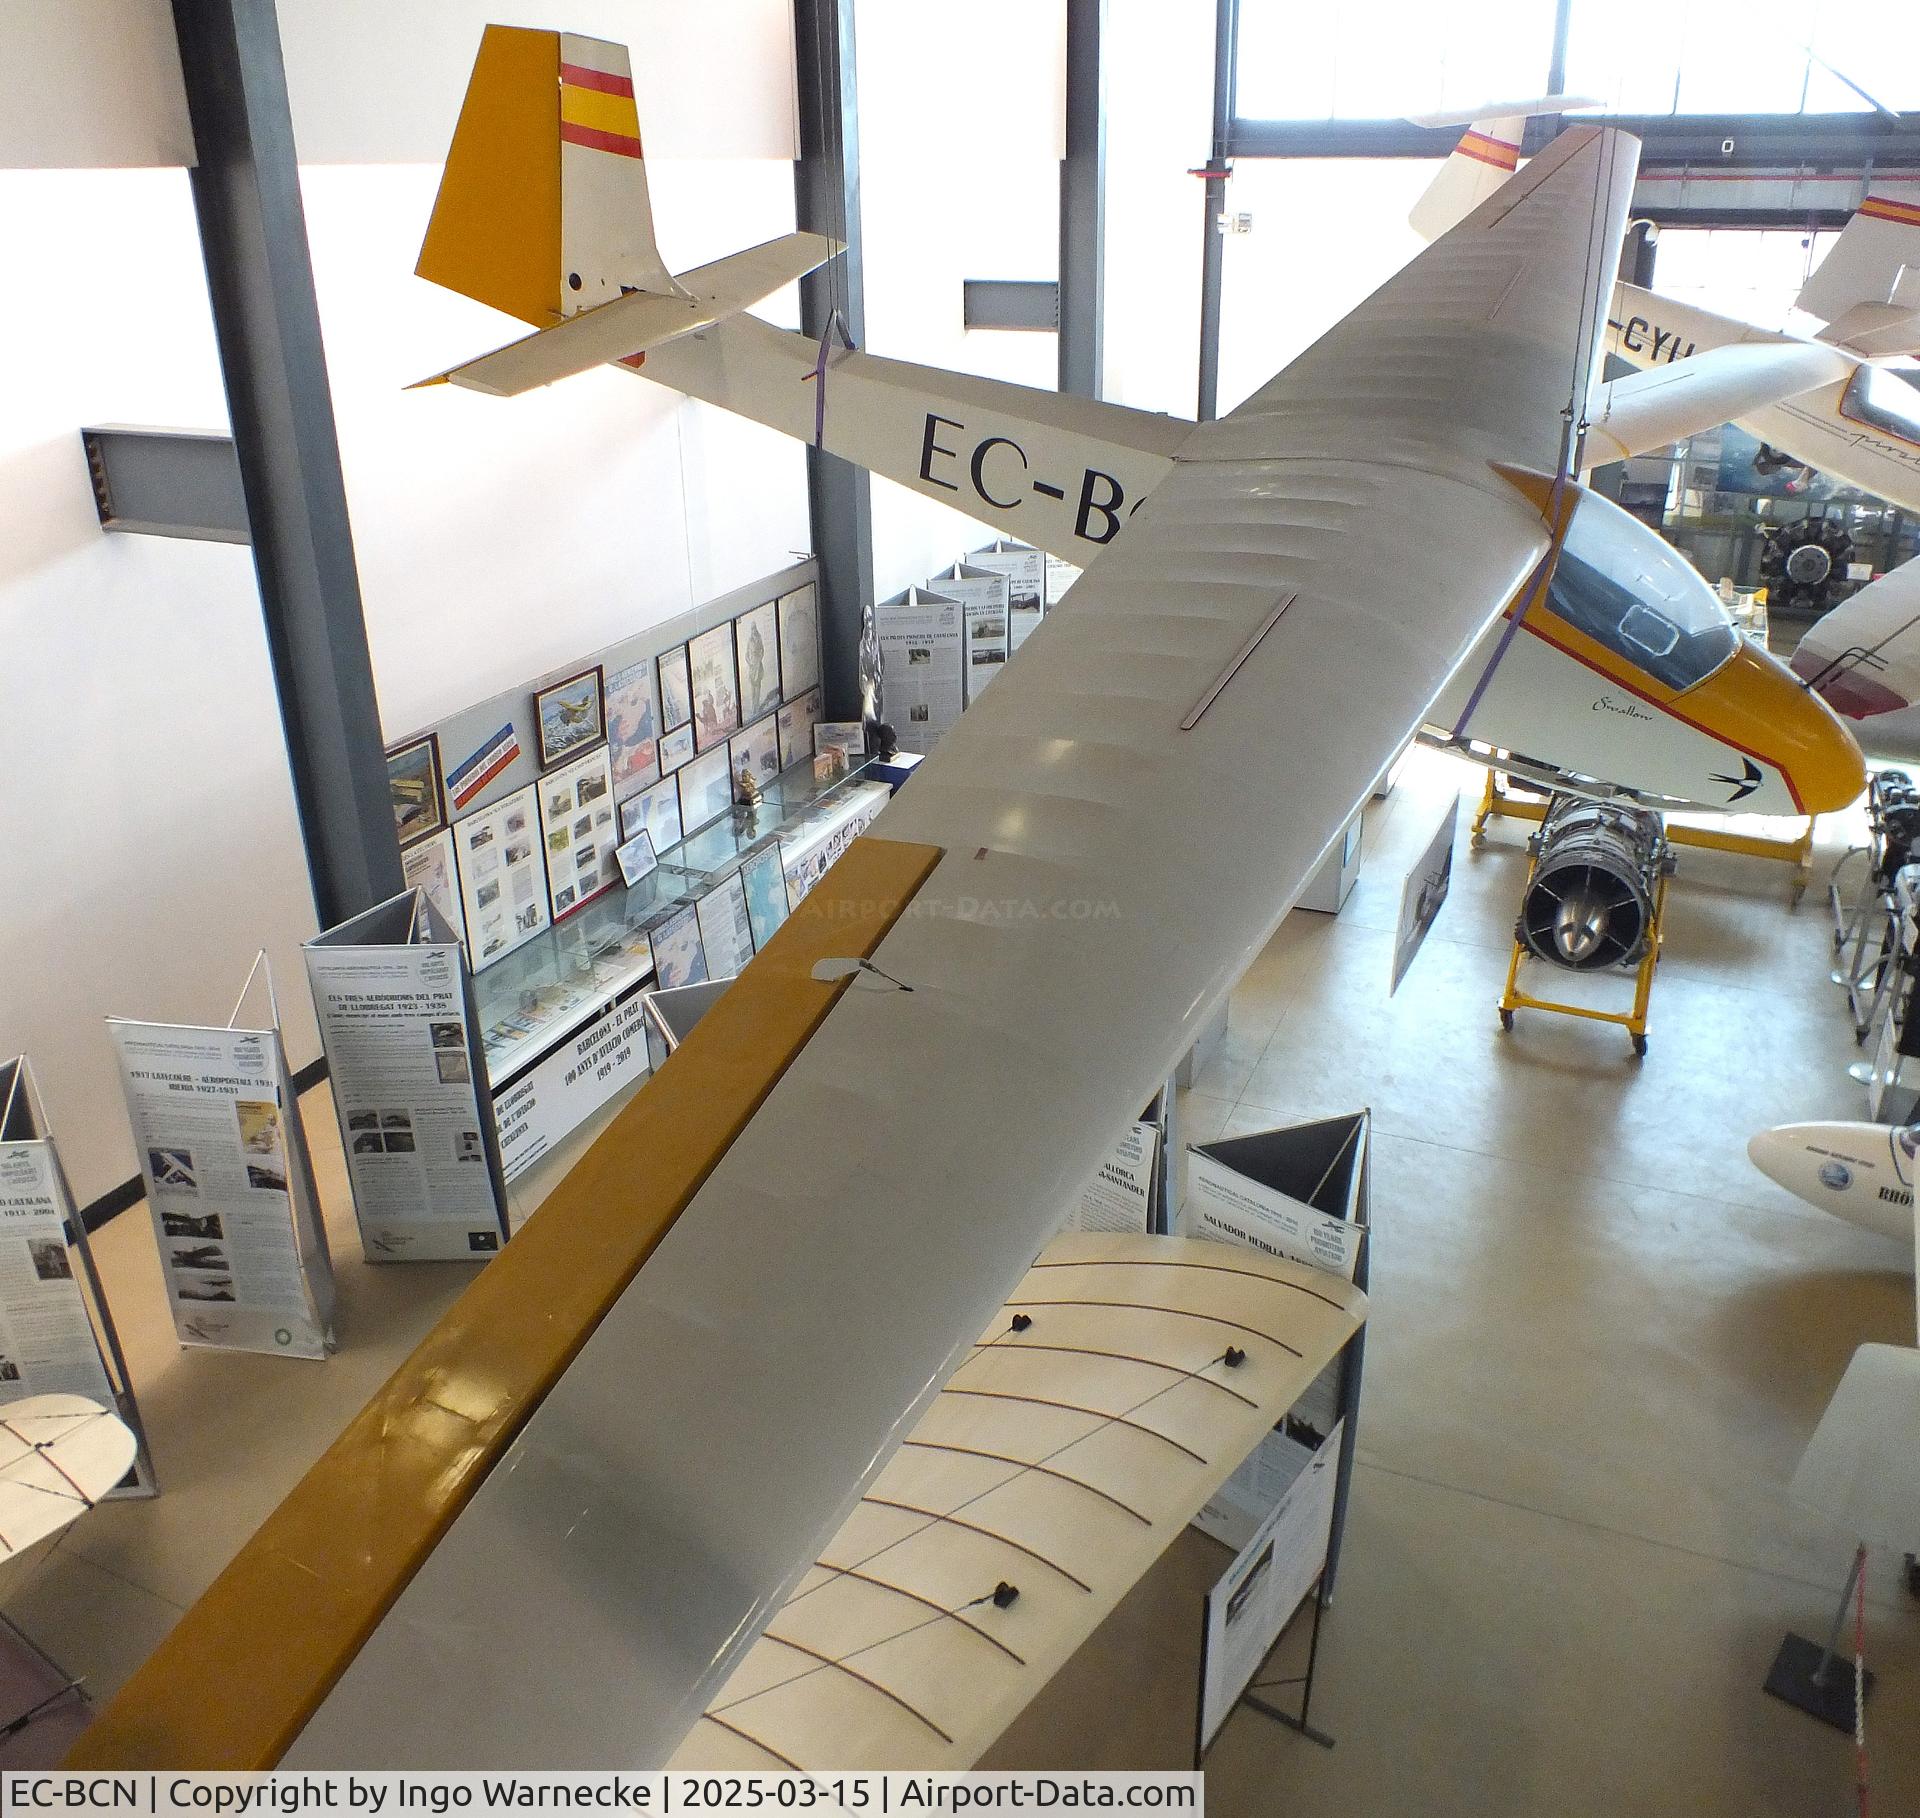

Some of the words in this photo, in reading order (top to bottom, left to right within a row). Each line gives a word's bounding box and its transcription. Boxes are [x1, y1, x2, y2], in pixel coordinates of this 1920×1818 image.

[920, 413, 1147, 544] EC-B
[1592, 696, 1653, 720] Swallow
[576, 1022, 612, 1056] BARCELONA
[615, 1013, 623, 1027] EL
[623, 1001, 639, 1021] PRAT
[564, 1069, 577, 1087] 100
[596, 1062, 612, 1081] 1919
[615, 1046, 632, 1066] 2019
[1203, 1212, 1247, 1240] SALVADOR
